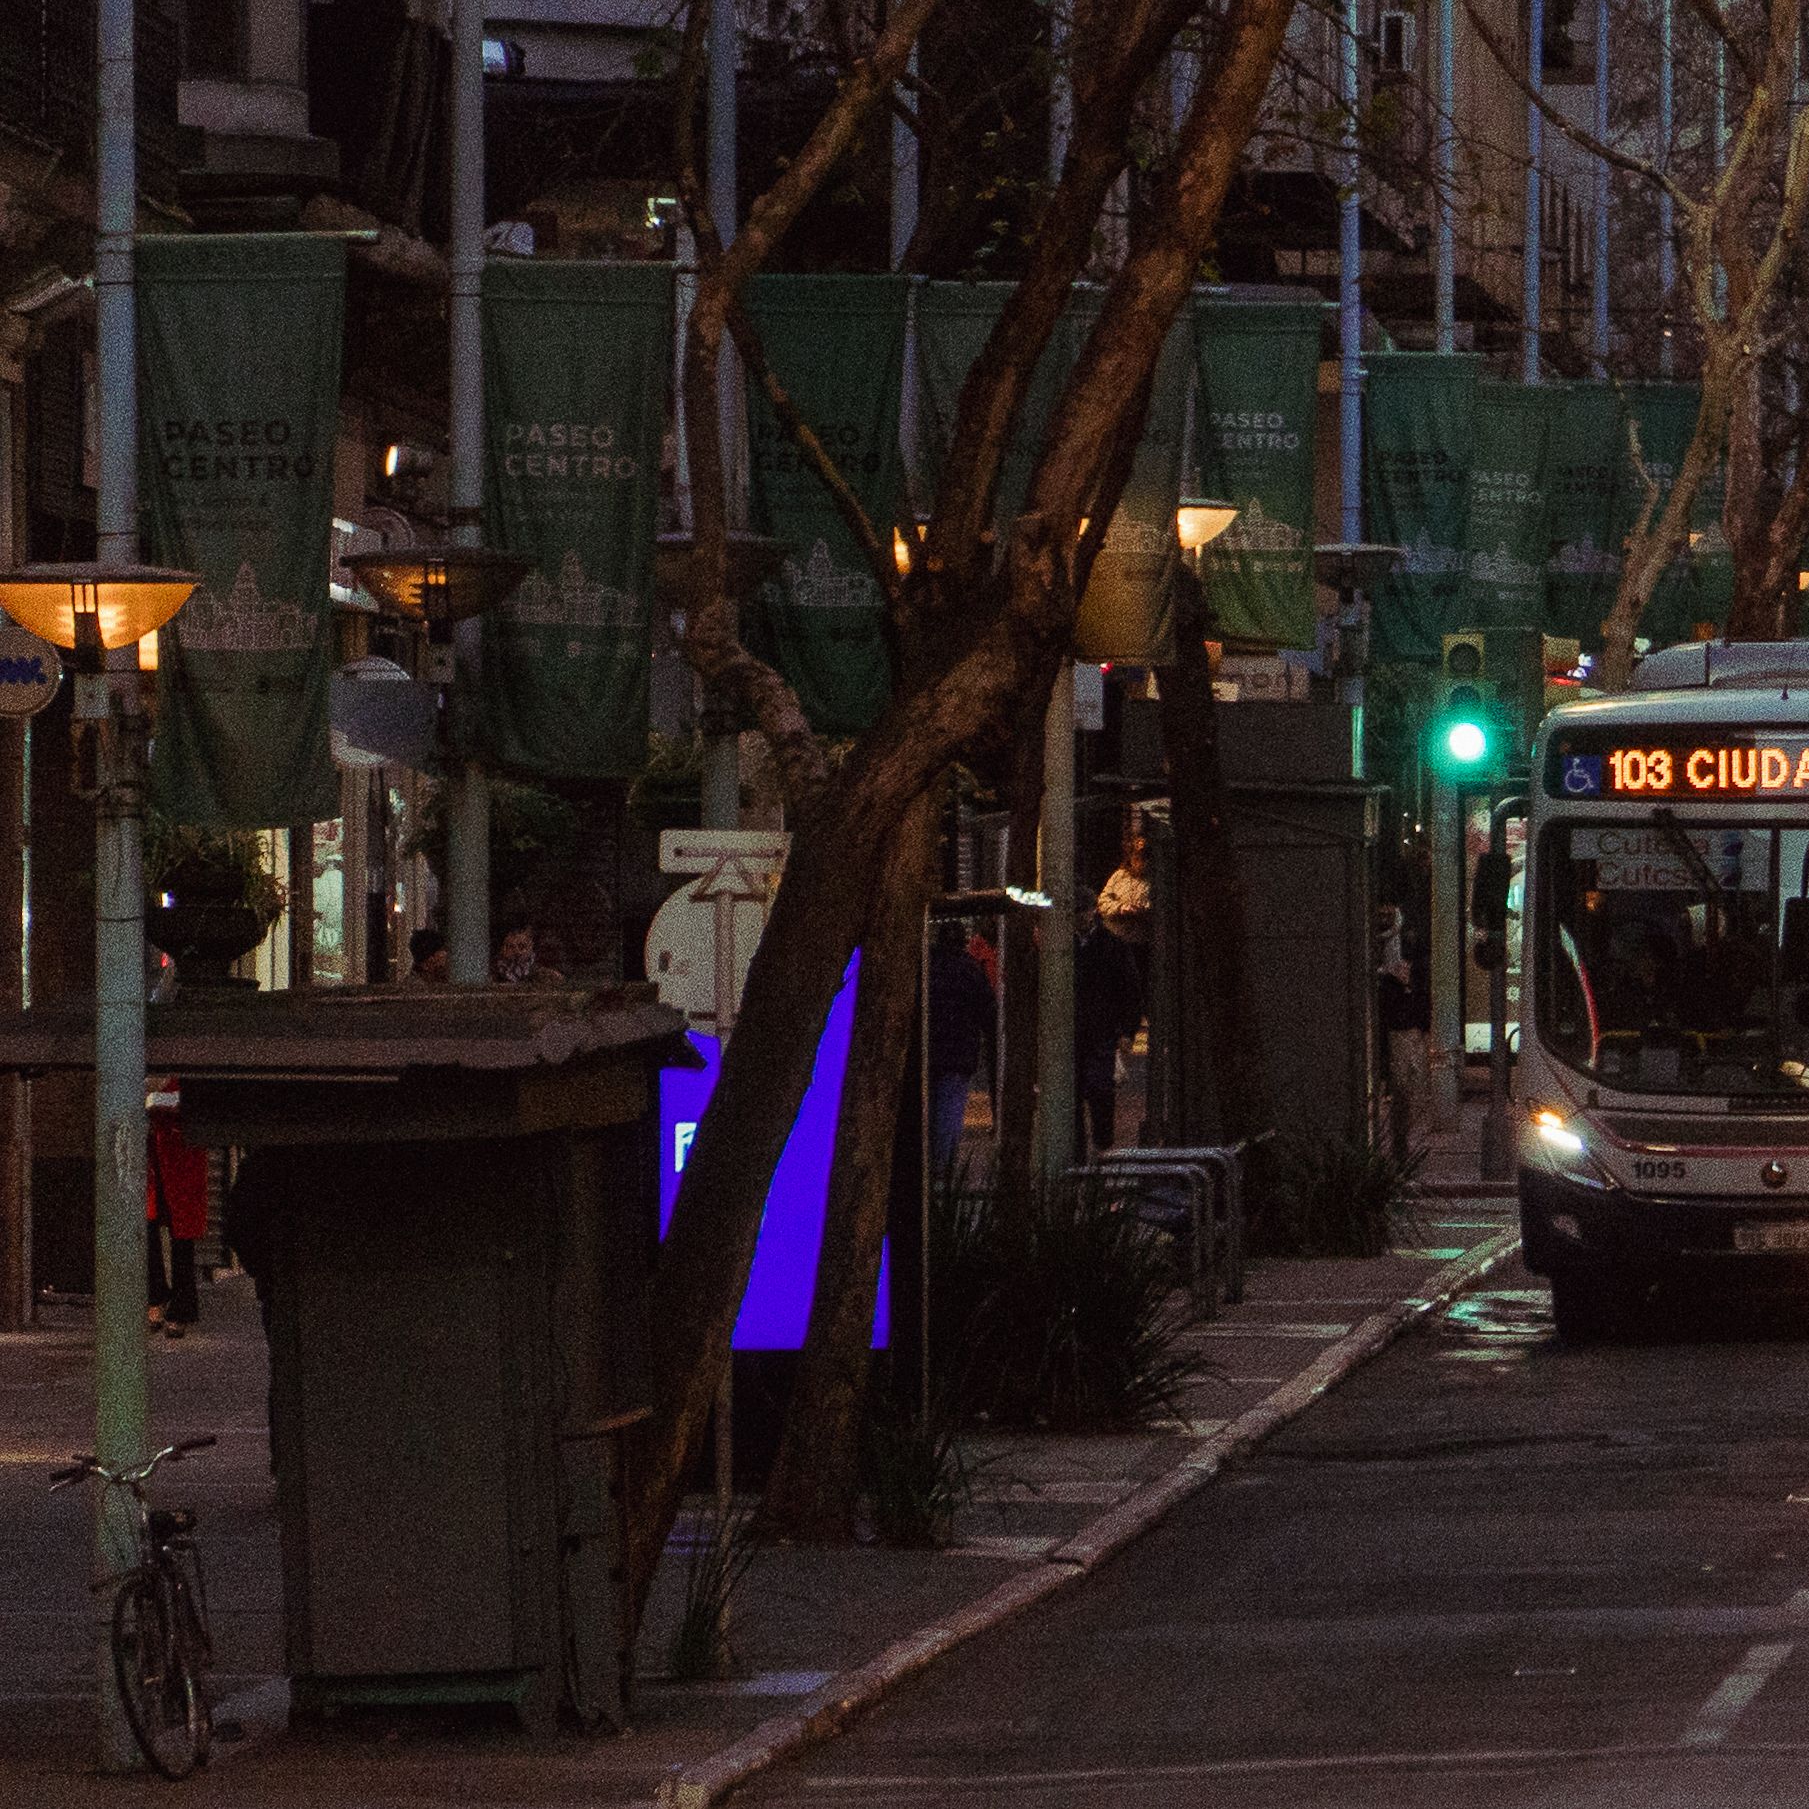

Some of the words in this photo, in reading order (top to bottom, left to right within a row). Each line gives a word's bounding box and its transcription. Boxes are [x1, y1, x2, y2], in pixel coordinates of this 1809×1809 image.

[166, 420, 291, 445] PASEO
[507, 423, 614, 448] PASEO
[1218, 431, 1299, 450] ENTRO
[160, 453, 314, 480] CENTRO
[504, 455, 638, 480] CENTRO
[1471, 488, 1543, 505] ENTRO
[1609, 749, 1673, 790] 103
[1598, 832, 1709, 856] Cutca
[1632, 1162, 1687, 1180] 1095
